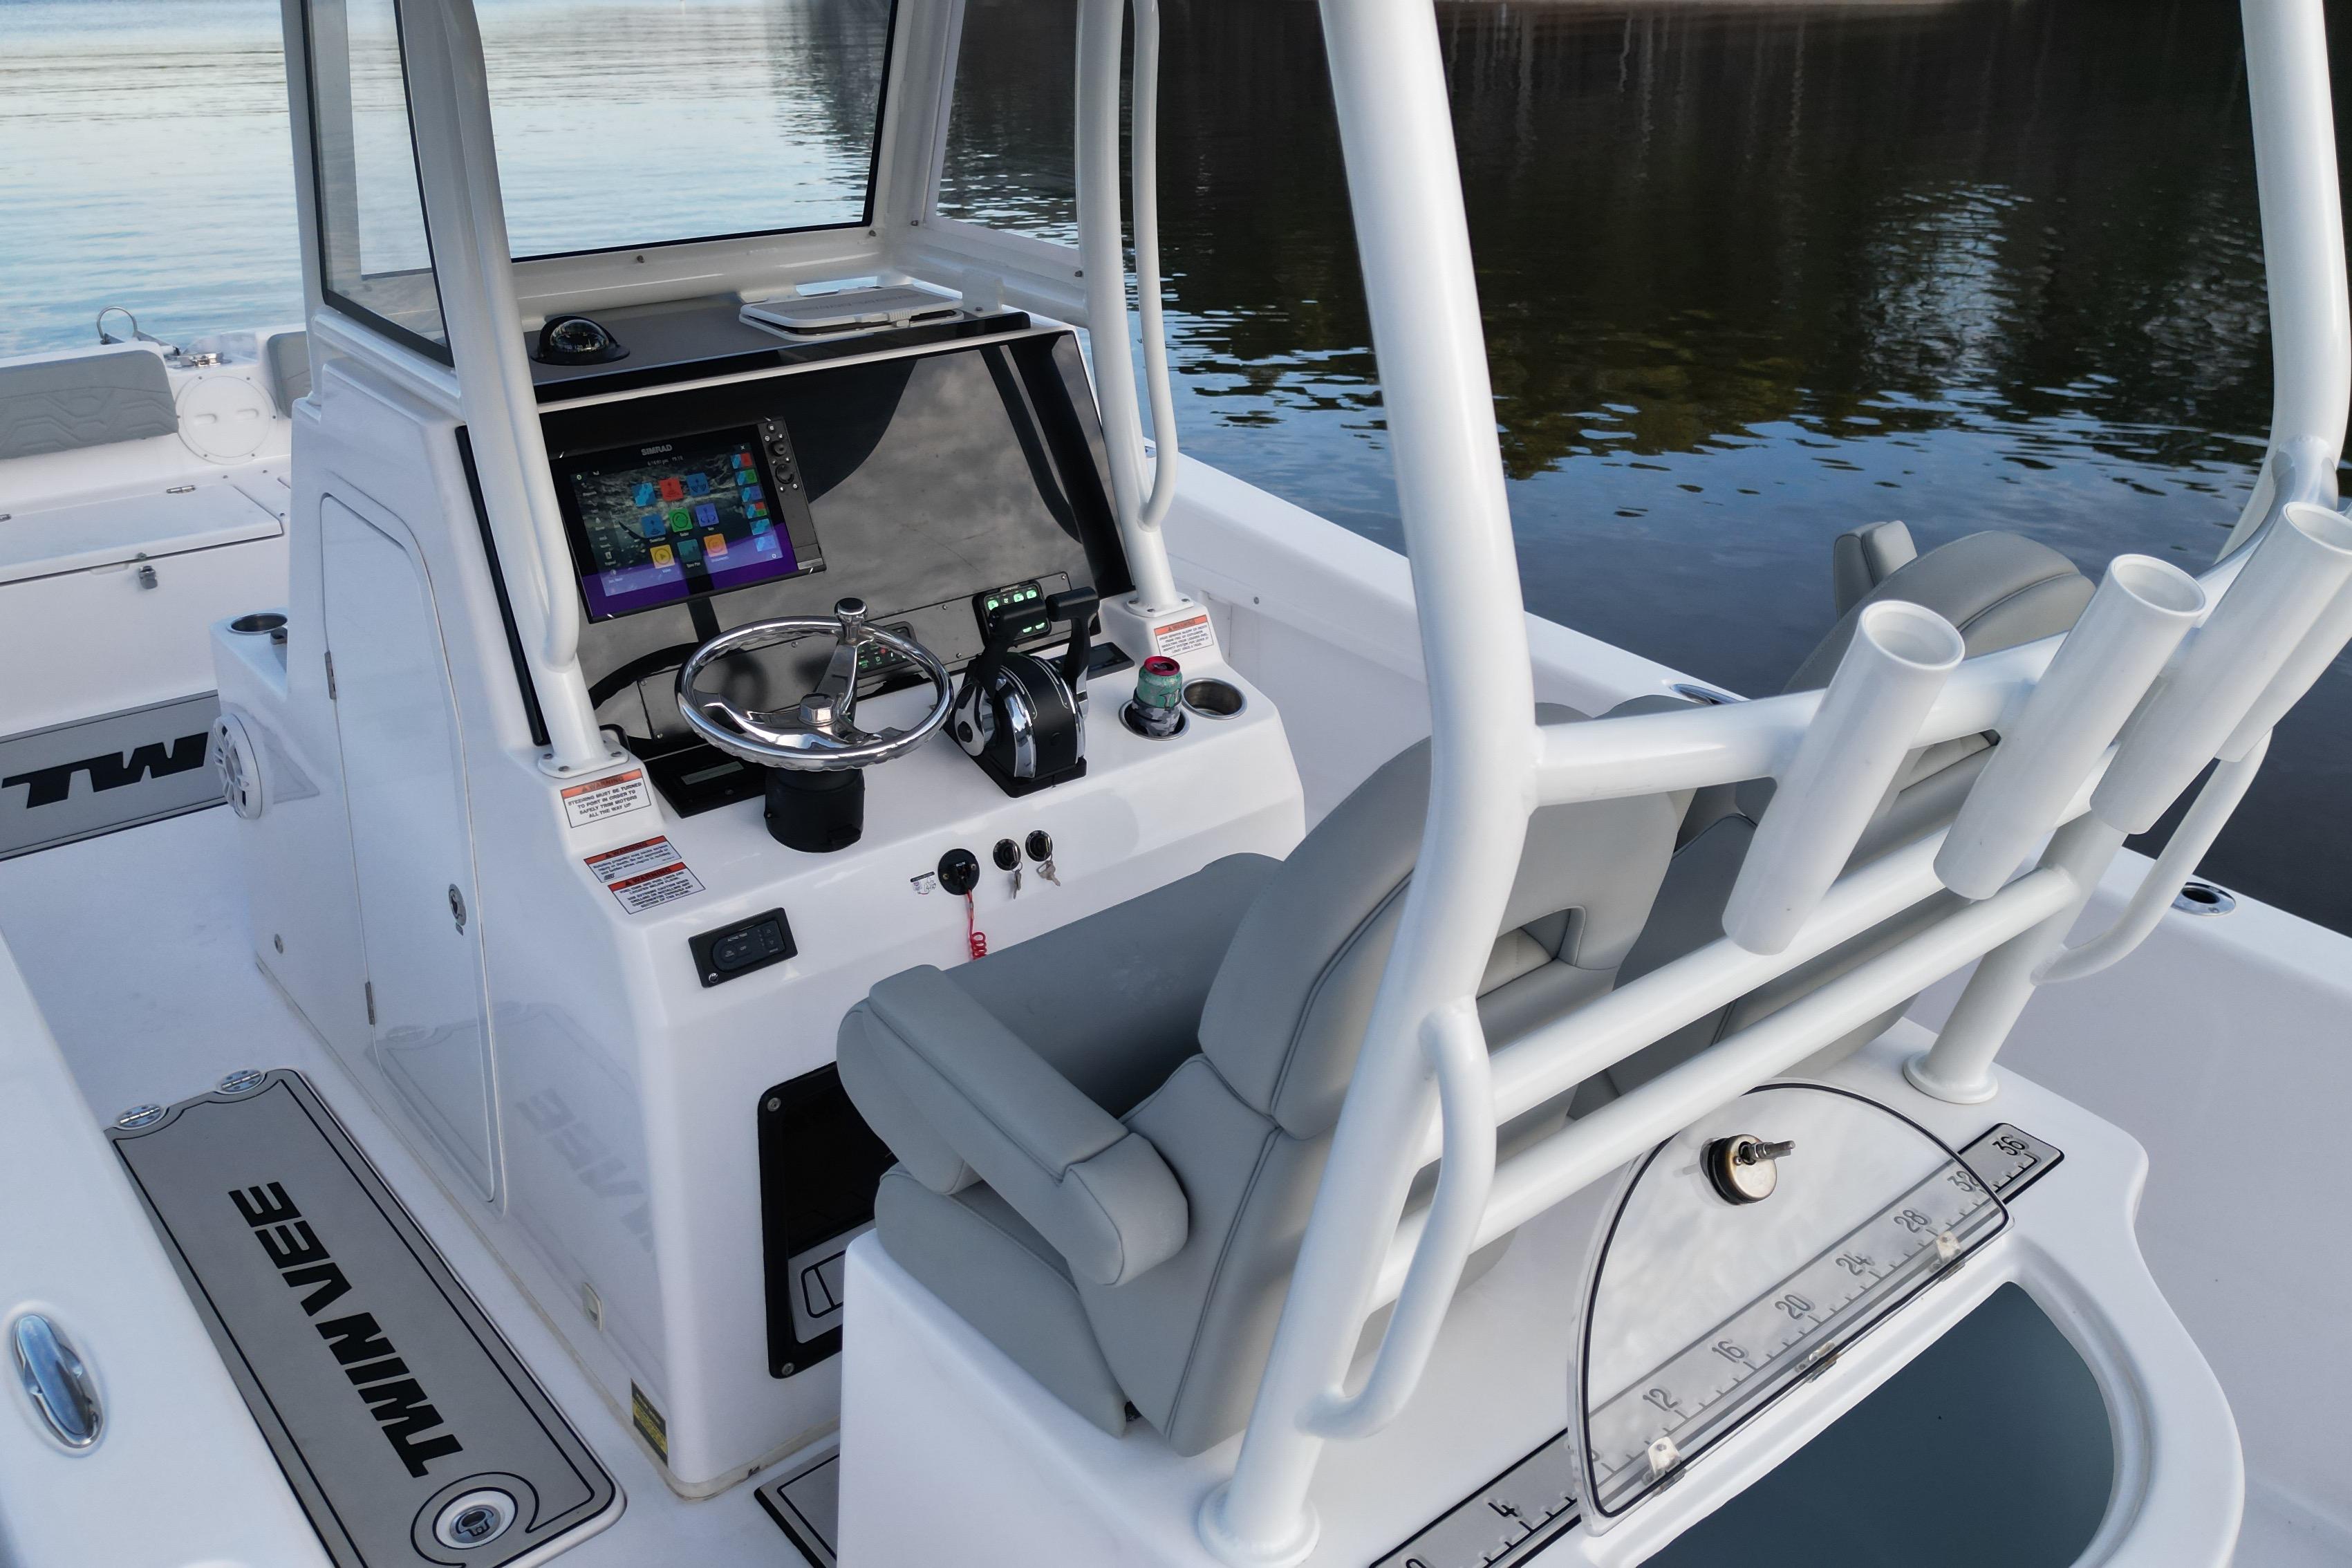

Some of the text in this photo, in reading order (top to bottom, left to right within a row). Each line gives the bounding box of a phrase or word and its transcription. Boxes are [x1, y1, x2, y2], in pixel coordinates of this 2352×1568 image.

[641, 444, 673, 456] SIMRAD
[588, 775, 624, 790] WARNING
[595, 790, 610, 799] MUST
[620, 781, 642, 791] TURNED
[631, 867, 672, 884] WARNING
[1992, 1135, 2026, 1157] 36
[1946, 1170, 1981, 1193] 32
[1893, 1208, 1929, 1234] 28
[1836, 1253, 1871, 1276] 24
[1774, 1294, 1811, 1320] 20
[228, 1181, 464, 1480] TWIN VEE
[1711, 1341, 1746, 1364] 16
[1642, 1388, 1680, 1412] 12
[1487, 1501, 1520, 1518] 4
